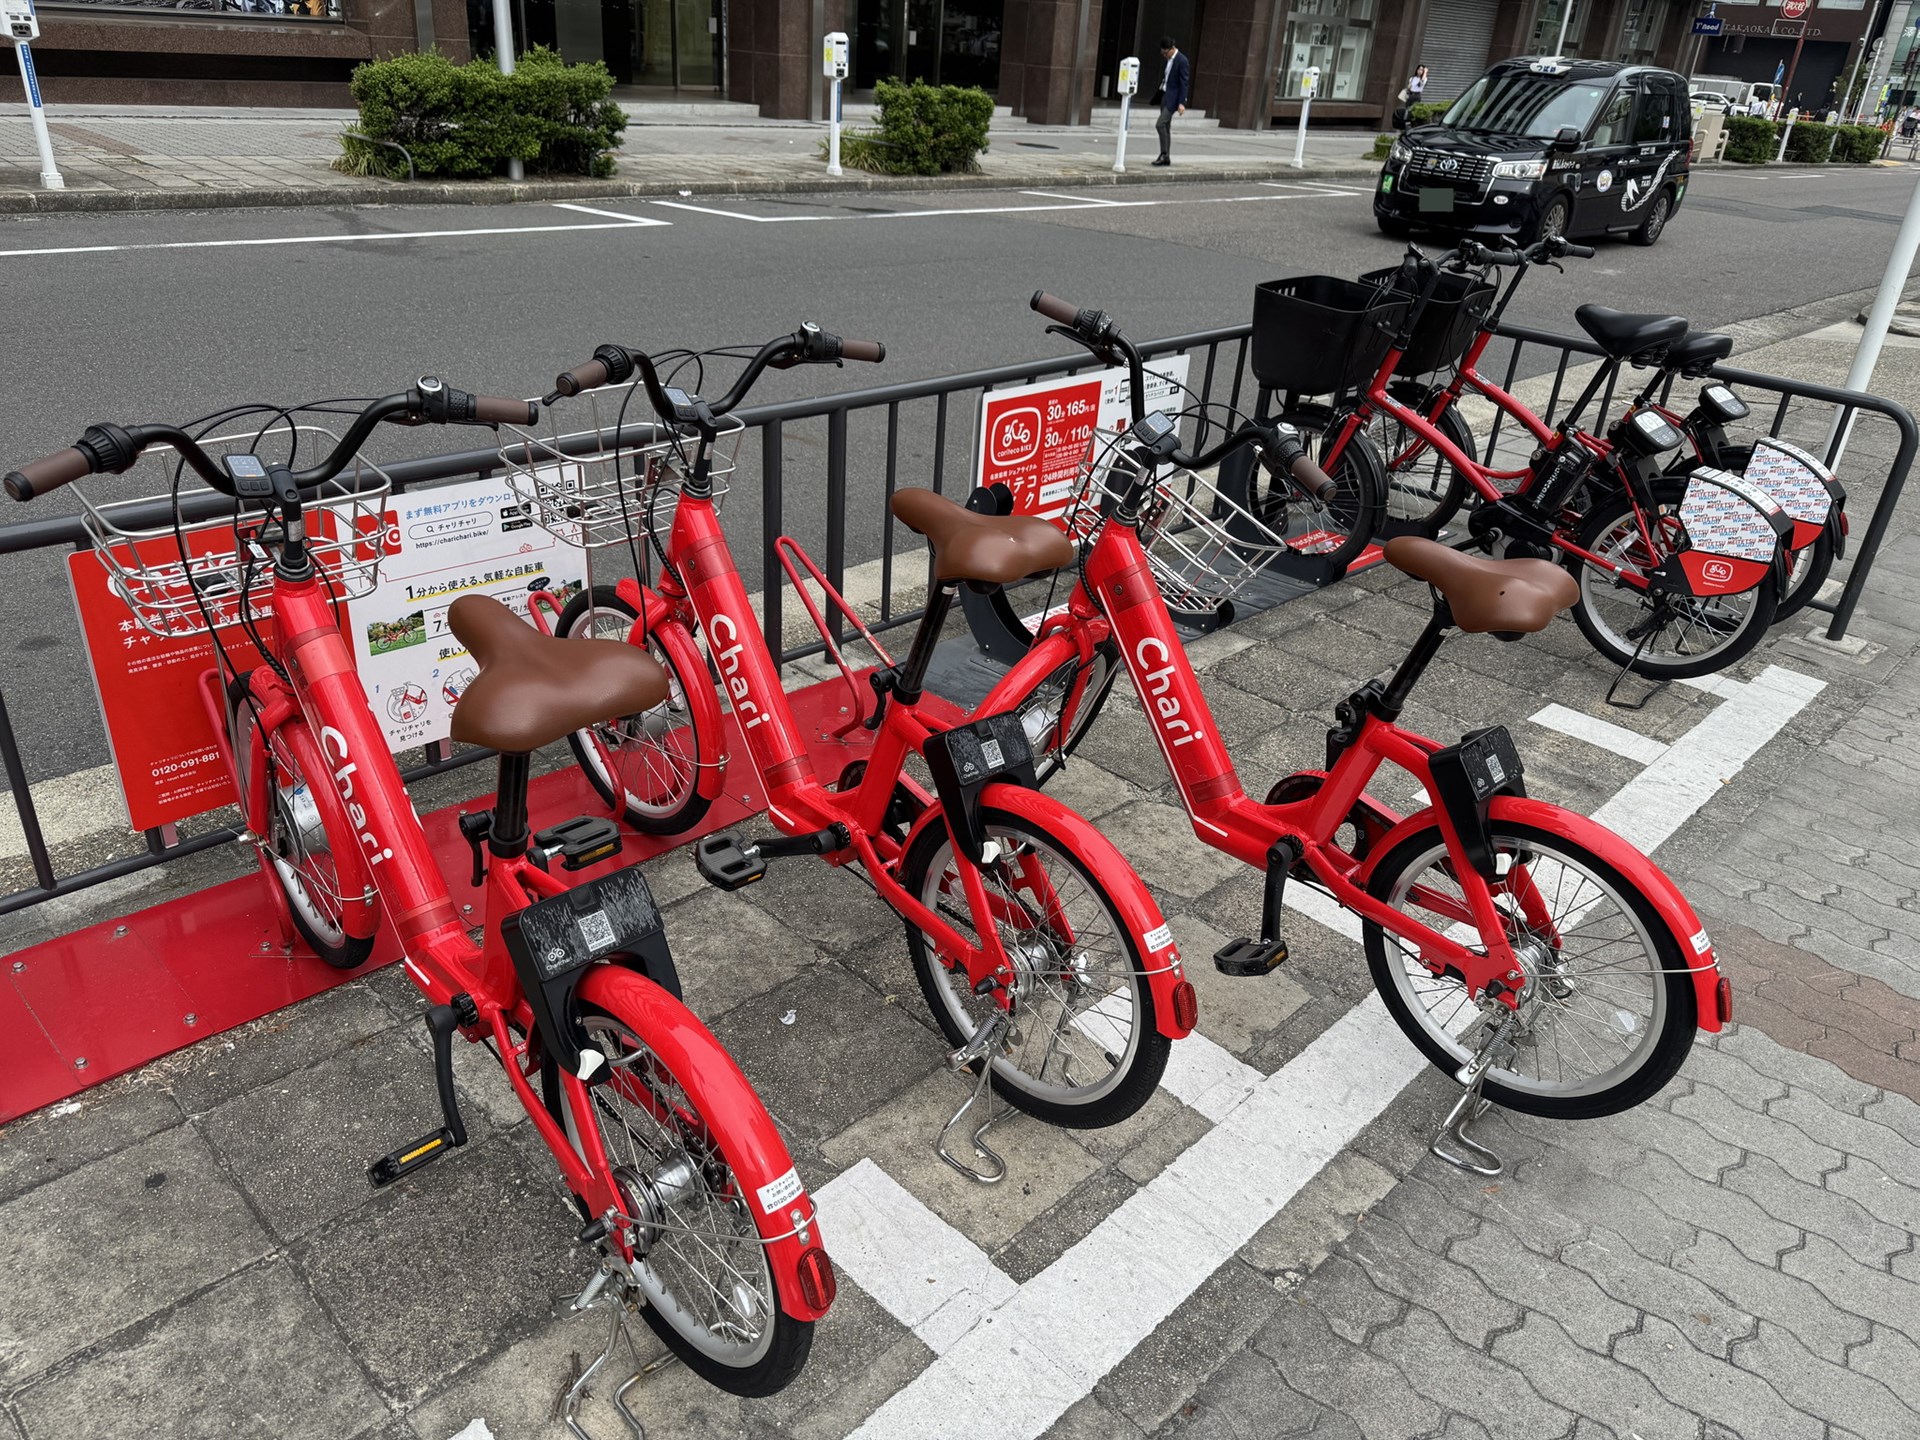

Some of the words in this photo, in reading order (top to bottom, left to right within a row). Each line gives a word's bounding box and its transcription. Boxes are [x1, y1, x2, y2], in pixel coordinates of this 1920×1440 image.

[438, 518, 477, 531] チャリチャリ
[415, 529, 489, 549] https://charichari.bike/
[405, 561, 544, 600] 1分から使える、気軽な自転車
[432, 669, 440, 678] 2
[710, 613, 770, 729] Chari
[374, 684, 380, 694] 1
[1136, 637, 1203, 747] Chari
[389, 719, 432, 737] チャリチャリを
[399, 731, 424, 742] 見つける
[151, 751, 220, 777] 0120-091-881
[320, 725, 393, 866] Chari
